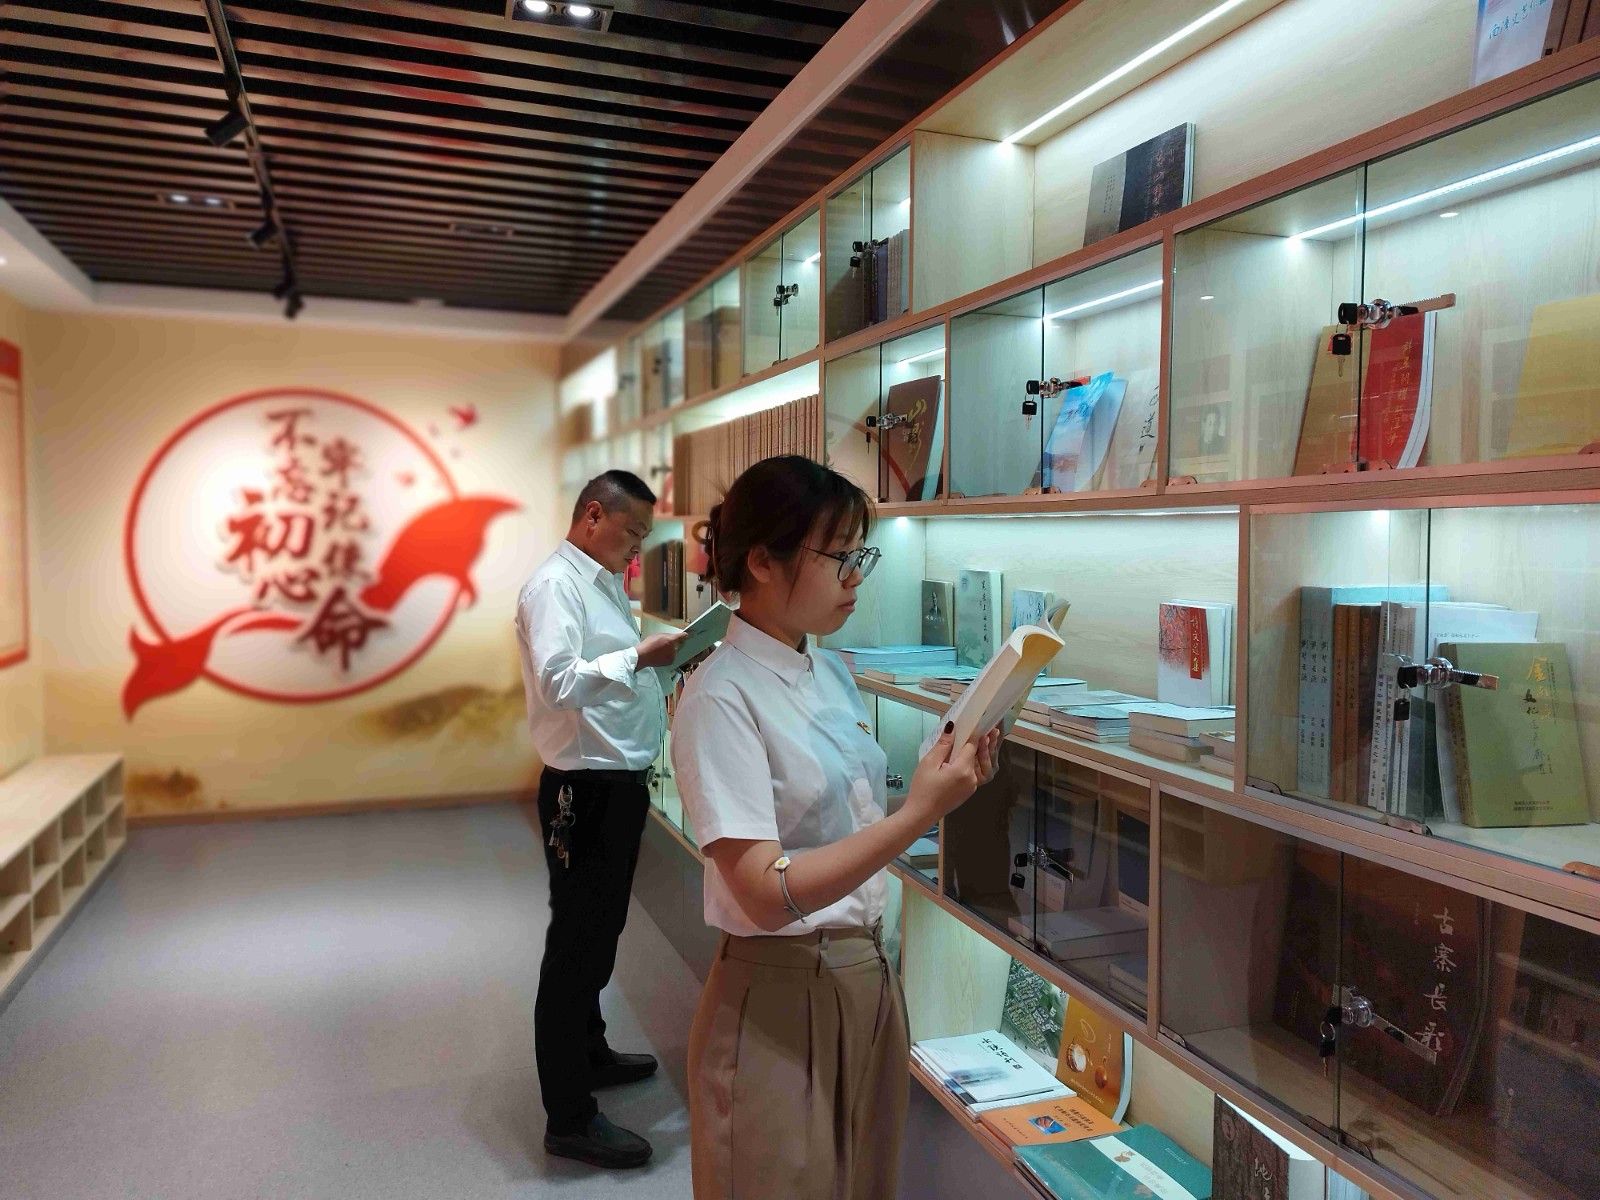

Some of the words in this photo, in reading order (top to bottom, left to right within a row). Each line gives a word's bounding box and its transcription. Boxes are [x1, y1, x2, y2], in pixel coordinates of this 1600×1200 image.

[226, 408, 320, 604] 不忘初心
[299, 437, 390, 673] 牢记使命
